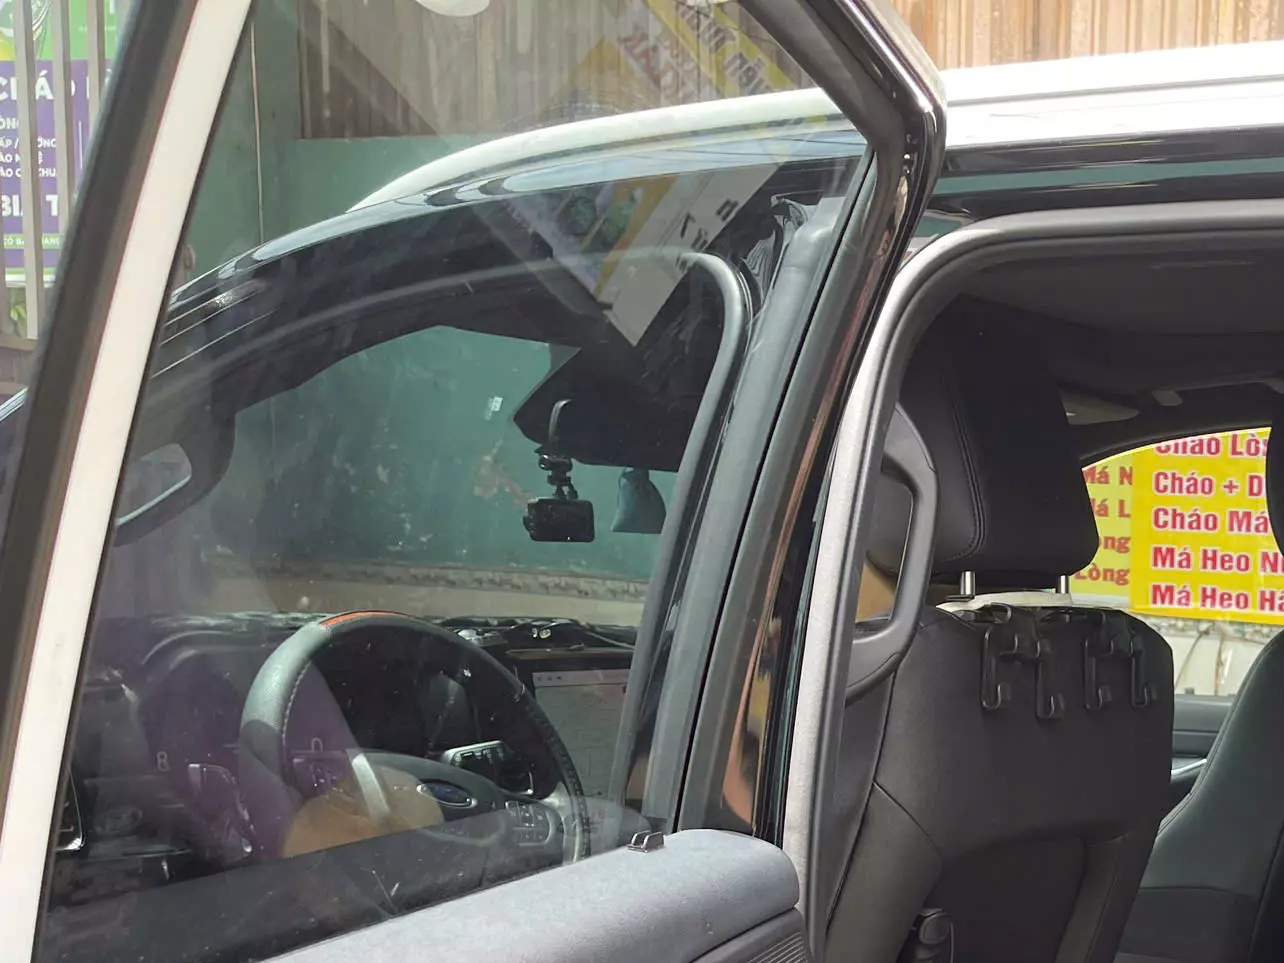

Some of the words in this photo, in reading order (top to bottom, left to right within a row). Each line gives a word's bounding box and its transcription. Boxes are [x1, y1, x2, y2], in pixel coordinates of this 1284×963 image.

[1154, 471, 1214, 495] Cháo
[1153, 507, 1218, 532] Cháo
[1152, 546, 1192, 570] Má
[1202, 549, 1251, 572] Heo
[1151, 584, 1191, 607] Má
[1201, 587, 1250, 610] Heo
